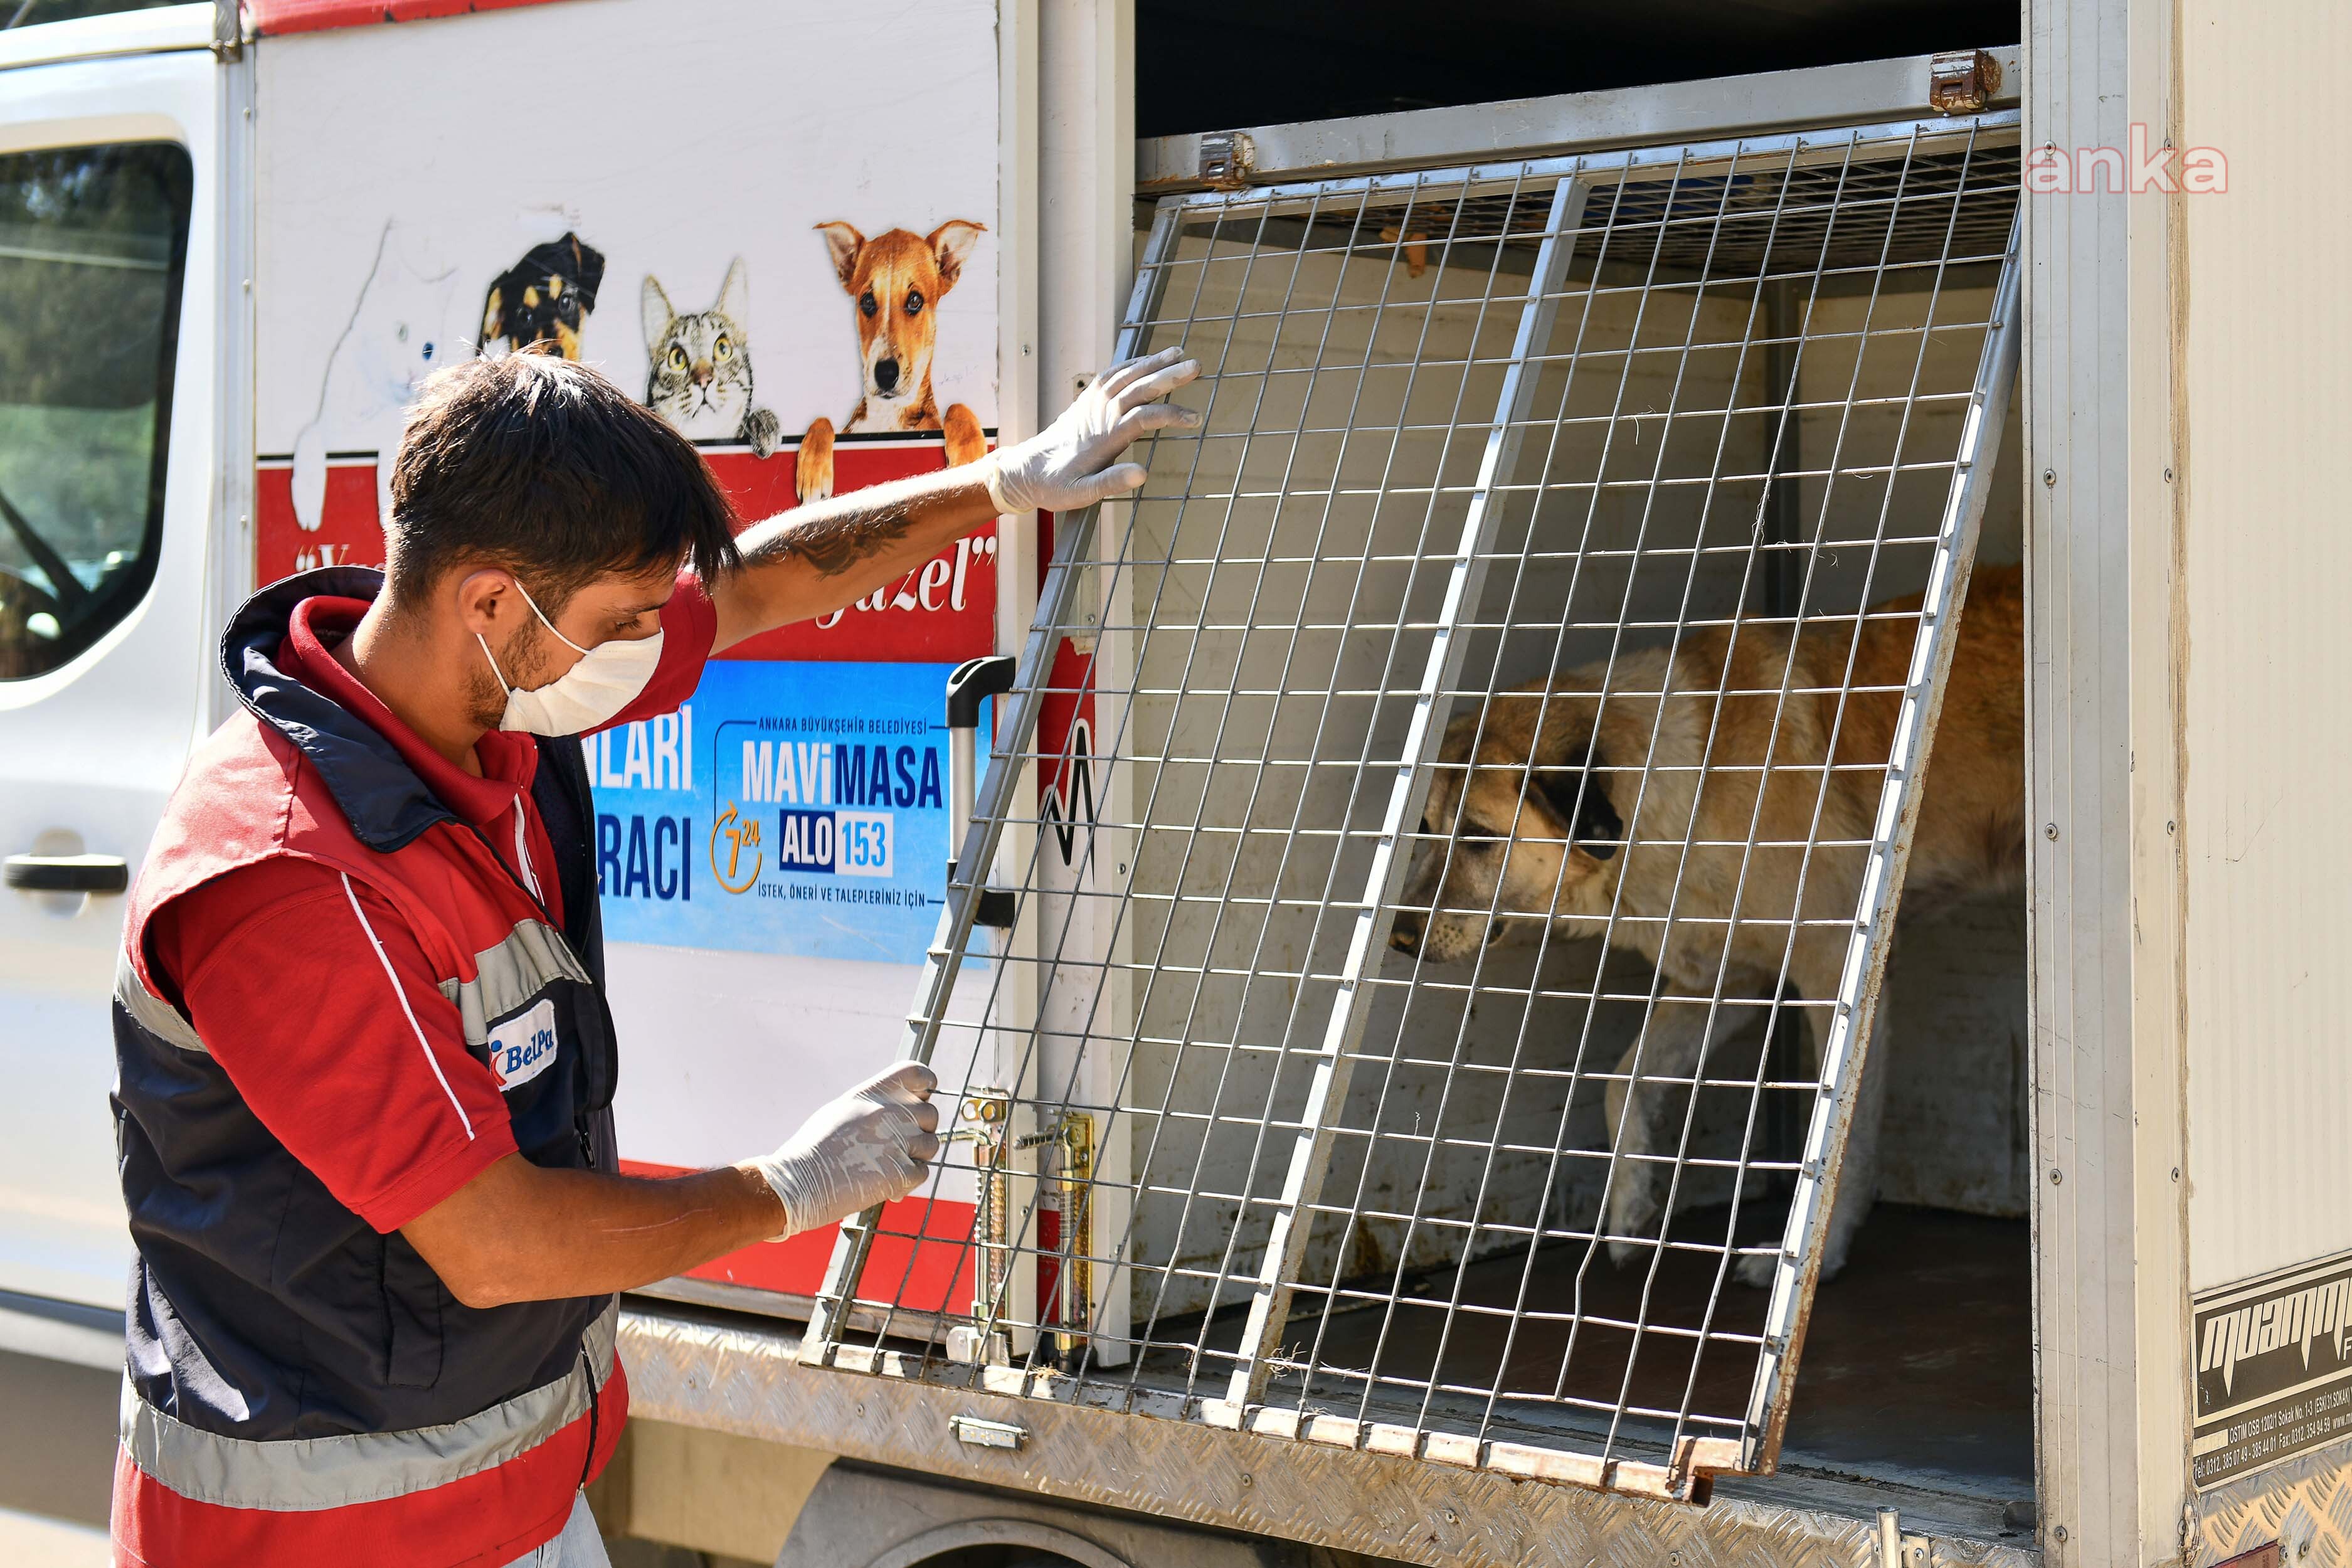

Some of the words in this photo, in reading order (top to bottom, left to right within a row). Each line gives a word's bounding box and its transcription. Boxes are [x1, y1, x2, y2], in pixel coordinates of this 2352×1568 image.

[758, 717, 797, 732] ANKARA
[801, 714, 864, 736] BÜYÜKŞEHİR
[869, 717, 927, 735] BELEDİYESİ
[782, 815, 833, 866] ALO
[842, 820, 886, 867] 153
[758, 880, 786, 900] İSTEK,
[790, 883, 817, 901] ÖNERİ
[820, 887, 832, 902] VE
[835, 887, 901, 906] TALEPLERİNİZ
[904, 889, 925, 910] İÇİN
[506, 1029, 553, 1074] BelPa
[2230, 1420, 2247, 1444] OSTİM
[2248, 1418, 2260, 1438] OSB
[2261, 1412, 2277, 1433] 1202/1
[2278, 1406, 2294, 1426] Sokak
[2295, 1404, 2304, 1421] No.
[2206, 1454, 2222, 1476] 0312.
[2223, 1450, 2232, 1470] 385
[2233, 1449, 2240, 1466] 07
[2241, 1446, 2248, 1463] 49
[2252, 1441, 2262, 1459] 385
[2262, 1438, 2269, 1455] 44
[2270, 1435, 2276, 1453] 01
[2279, 1433, 2291, 1449] Fax:
[2291, 1426, 2306, 1444] 0312.
[2306, 1421, 2316, 1439] 354
[2316, 1419, 2323, 1436] 94
[2324, 1416, 2331, 1433] 59
